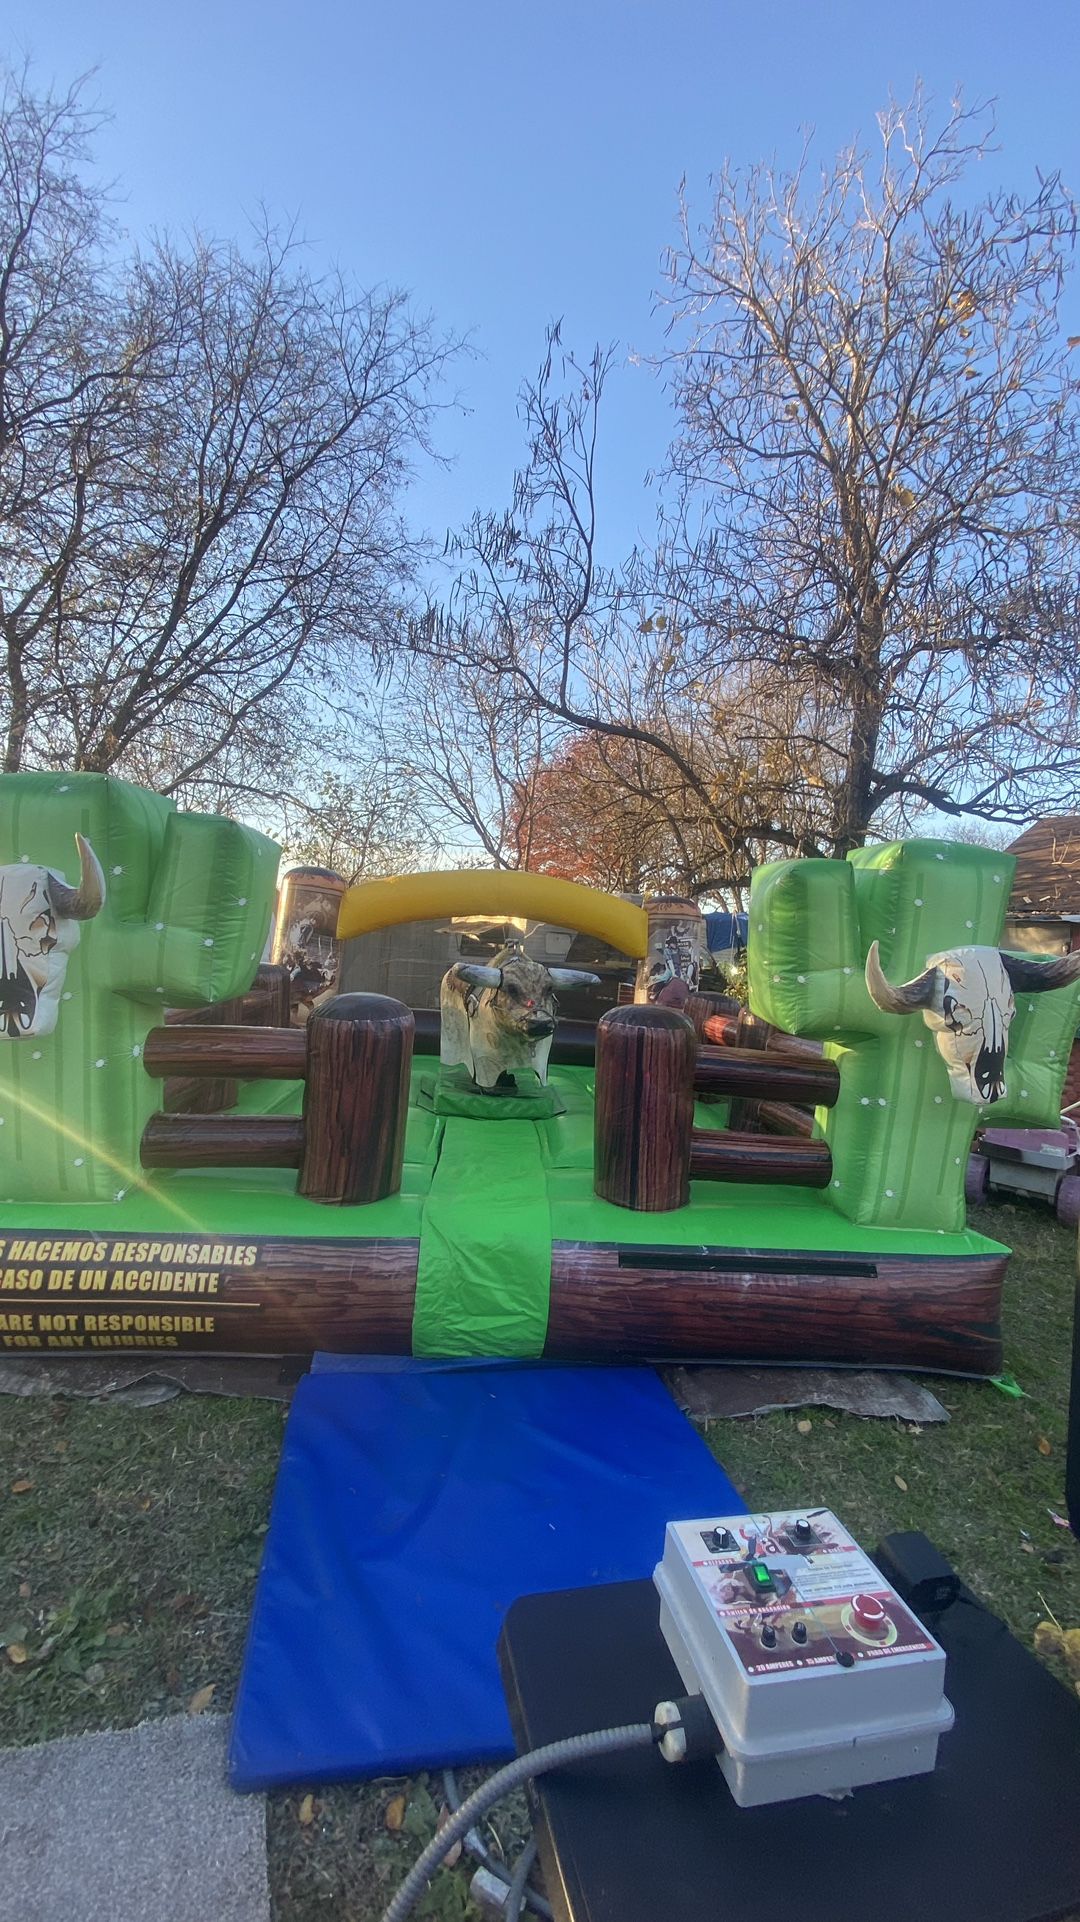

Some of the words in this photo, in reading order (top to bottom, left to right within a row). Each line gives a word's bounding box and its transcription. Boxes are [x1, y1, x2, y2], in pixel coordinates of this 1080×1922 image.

[7, 1240, 108, 1262] HACEMOS
[110, 1242, 258, 1266] RESPONSABLES
[0, 1268, 43, 1290] ASO
[48, 1269, 75, 1291] DE
[79, 1270, 108, 1291] UN
[110, 1270, 220, 1293] ACCIDENTE
[0, 1314, 33, 1331] ARE
[39, 1315, 78, 1331] NOT
[84, 1315, 215, 1332] RESPONSIBLE
[3, 1335, 42, 1347] FOR
[47, 1335, 85, 1347] ANY
[91, 1335, 178, 1347] INJURIES
